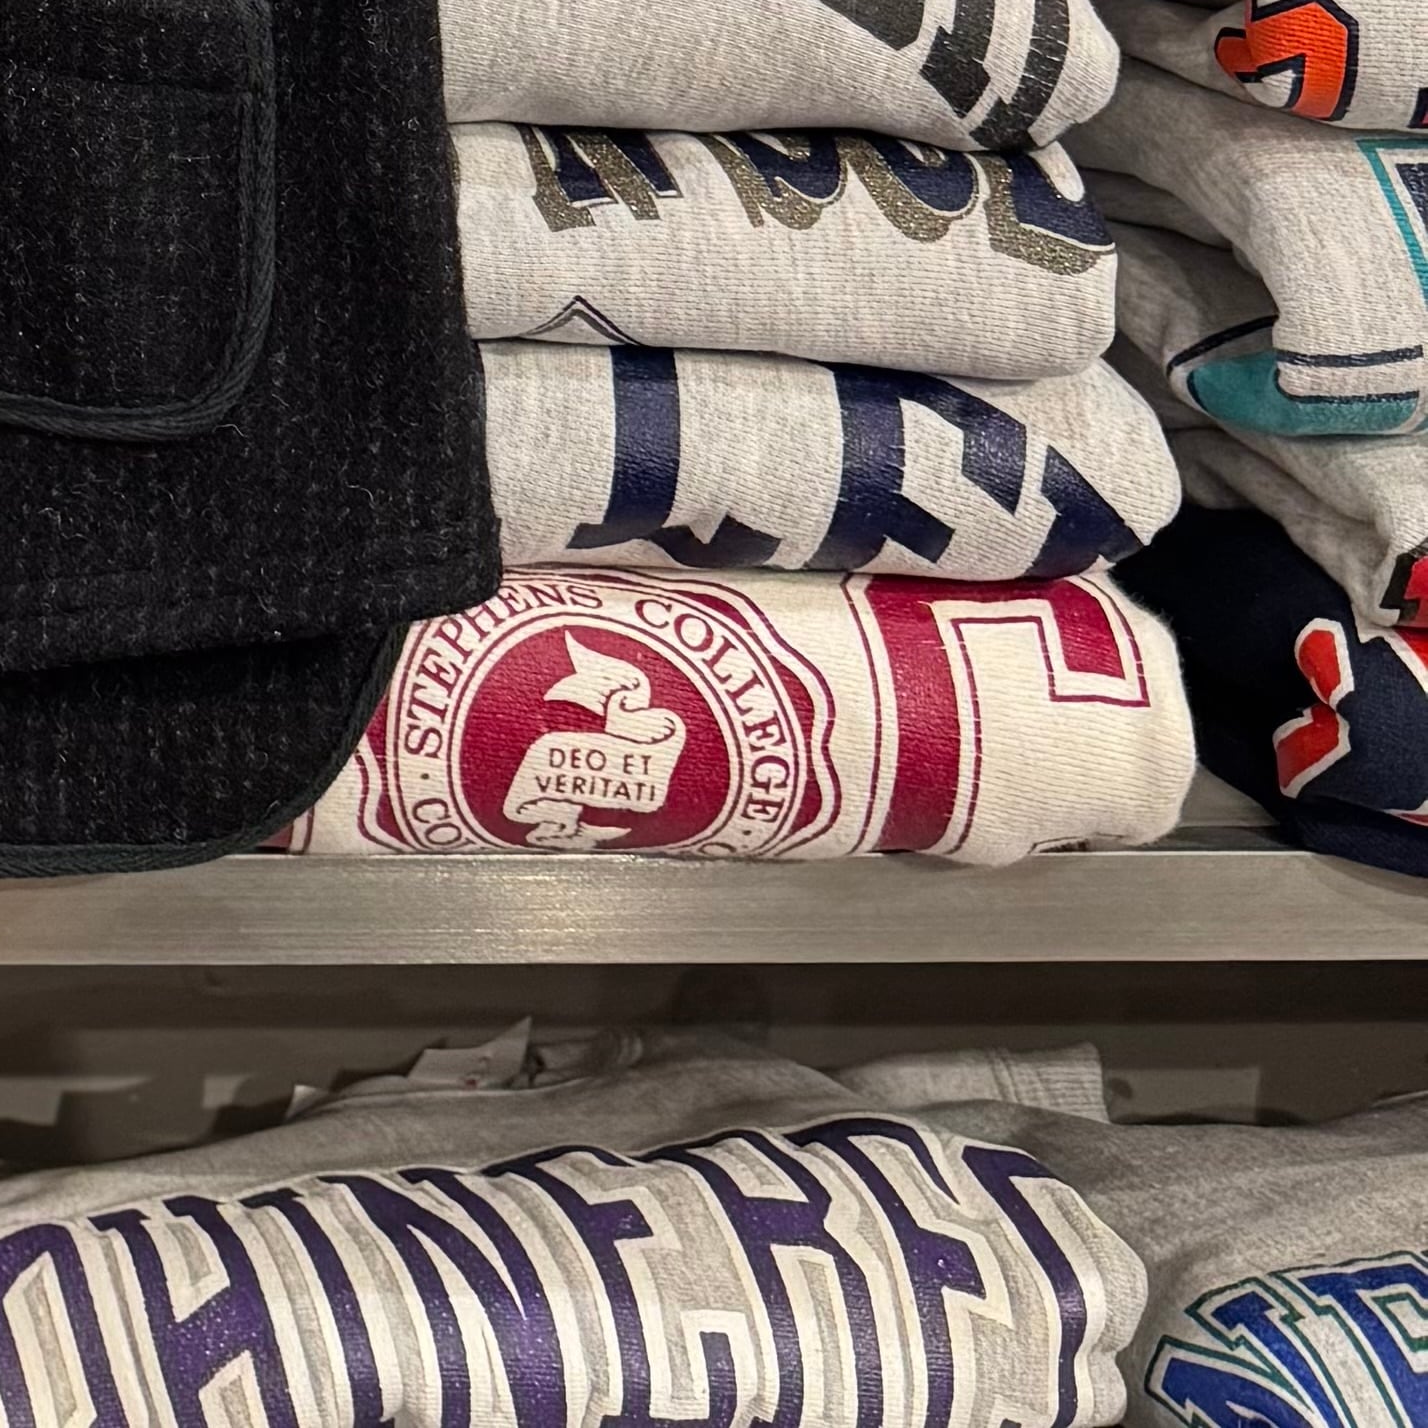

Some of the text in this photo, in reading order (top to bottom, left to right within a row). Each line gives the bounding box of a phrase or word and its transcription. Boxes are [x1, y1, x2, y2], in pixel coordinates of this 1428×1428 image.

[403, 582, 604, 760] STEPHENS
[633, 594, 791, 826] COLLEGE
[547, 747, 653, 777] DEO ET
[535, 773, 658, 803] VERITATI
